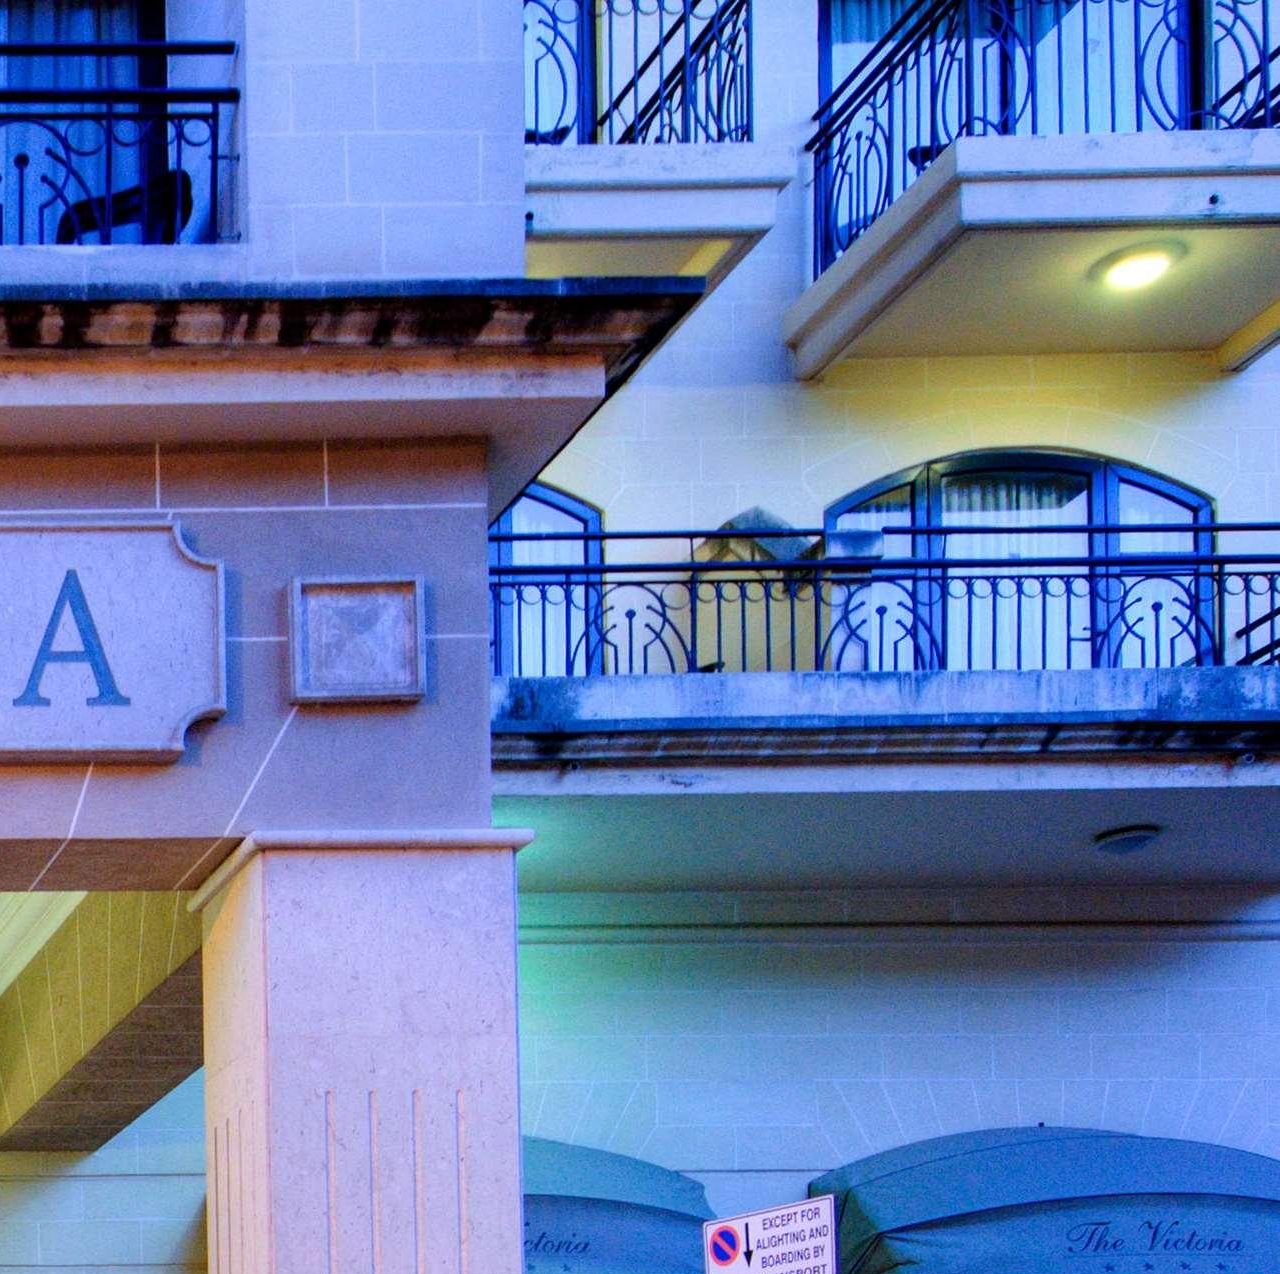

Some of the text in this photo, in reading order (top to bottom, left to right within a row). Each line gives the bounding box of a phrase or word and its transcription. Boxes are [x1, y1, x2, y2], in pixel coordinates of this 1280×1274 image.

[762, 1206, 821, 1231] EXCEPT FOR
[756, 1224, 829, 1250] ALIGHTING AND
[1066, 1220, 1242, 1253] The Victoria
[761, 1244, 825, 1269] BOARDING BY
